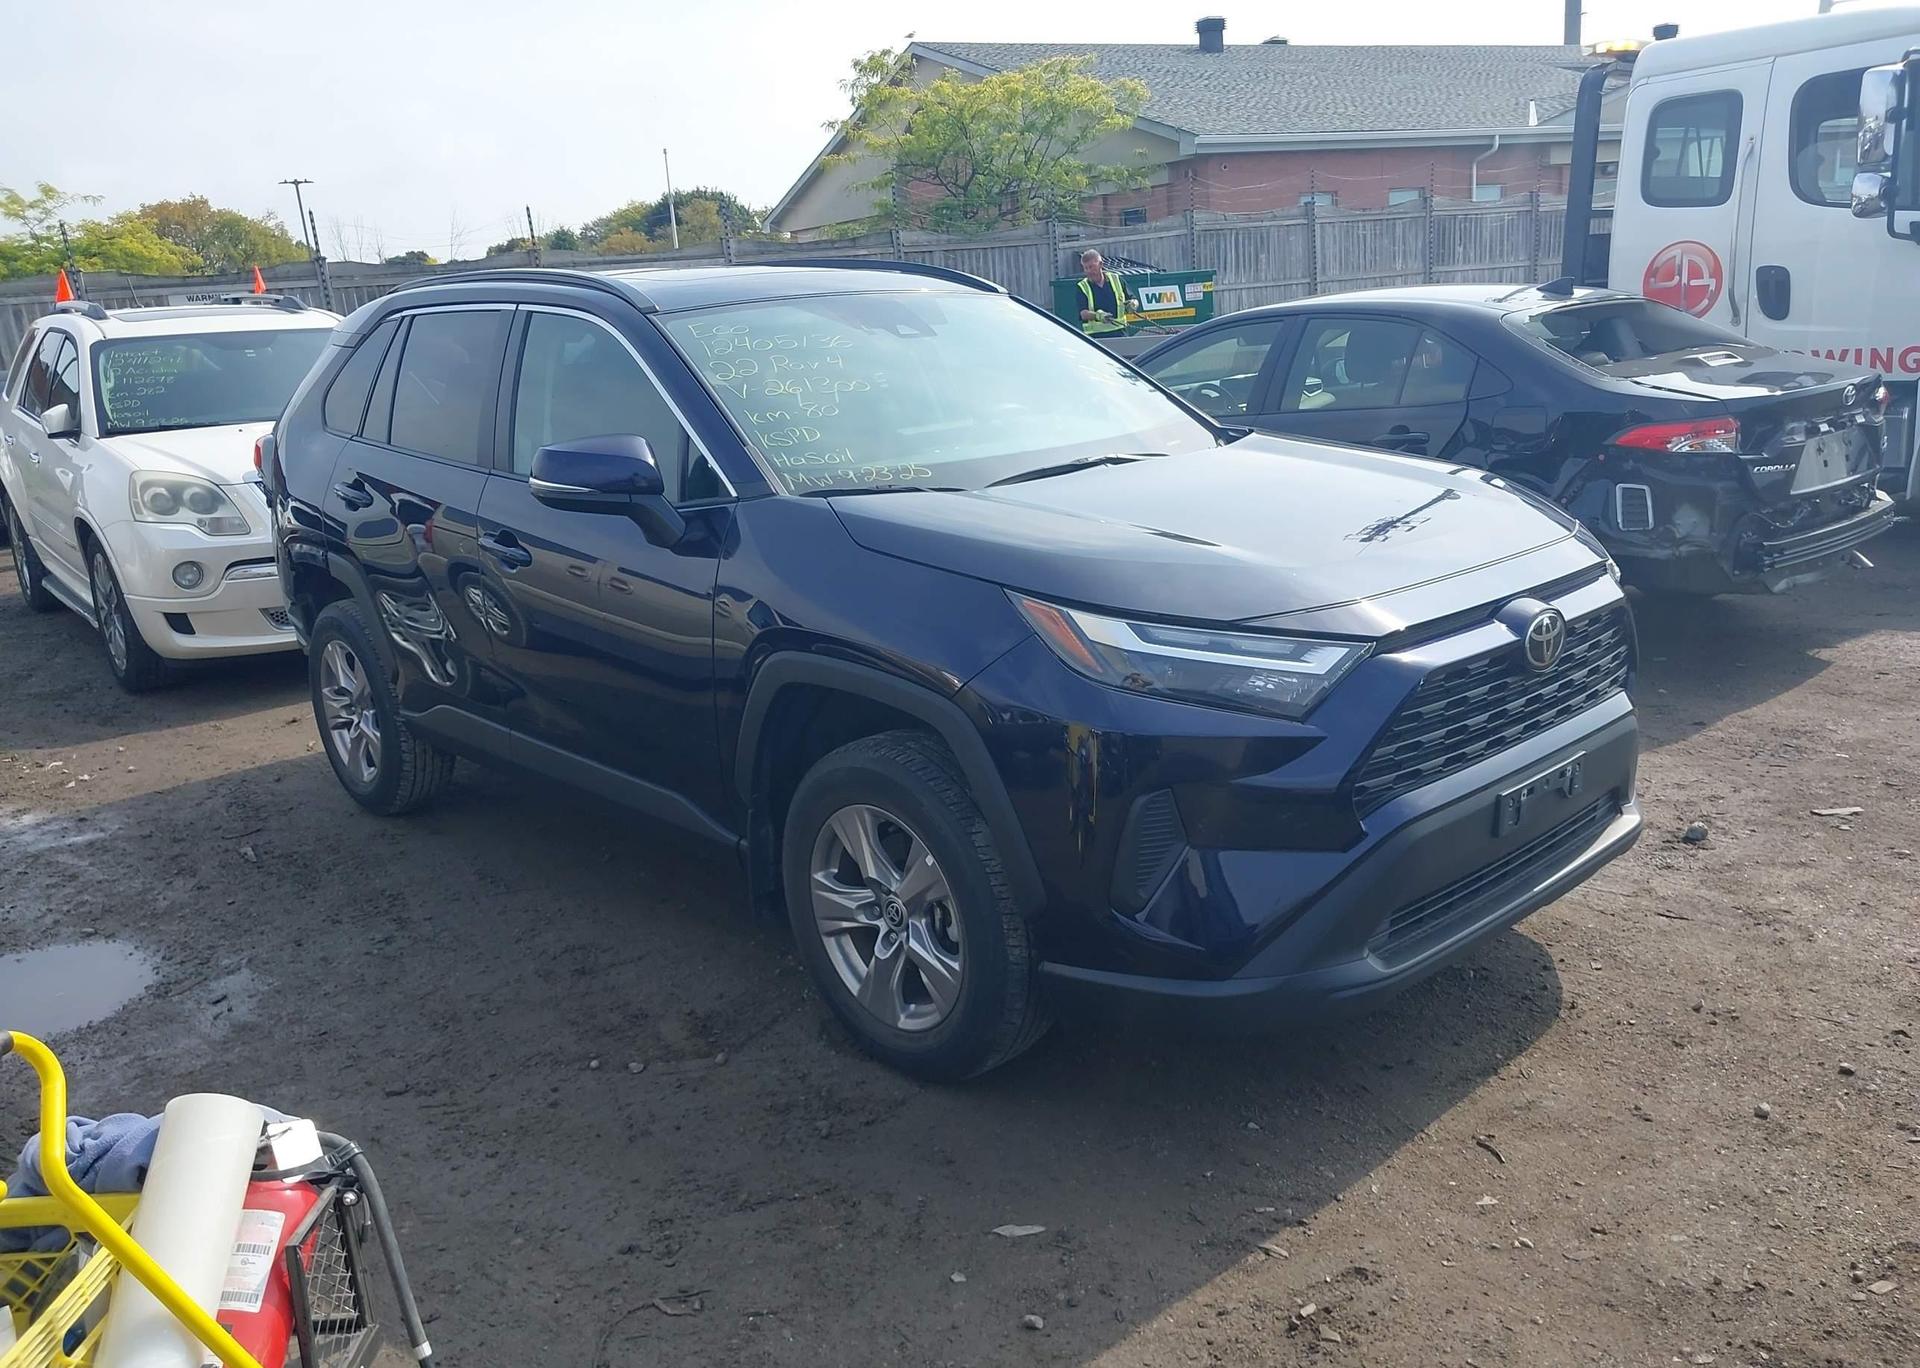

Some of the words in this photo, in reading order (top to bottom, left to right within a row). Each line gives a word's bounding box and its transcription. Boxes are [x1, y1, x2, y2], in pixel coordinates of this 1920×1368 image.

[185, 293, 231, 303] WARN
[1144, 291, 1177, 305] WM
[709, 358, 759, 380] 22
[1752, 463, 1796, 474] COROLLA
